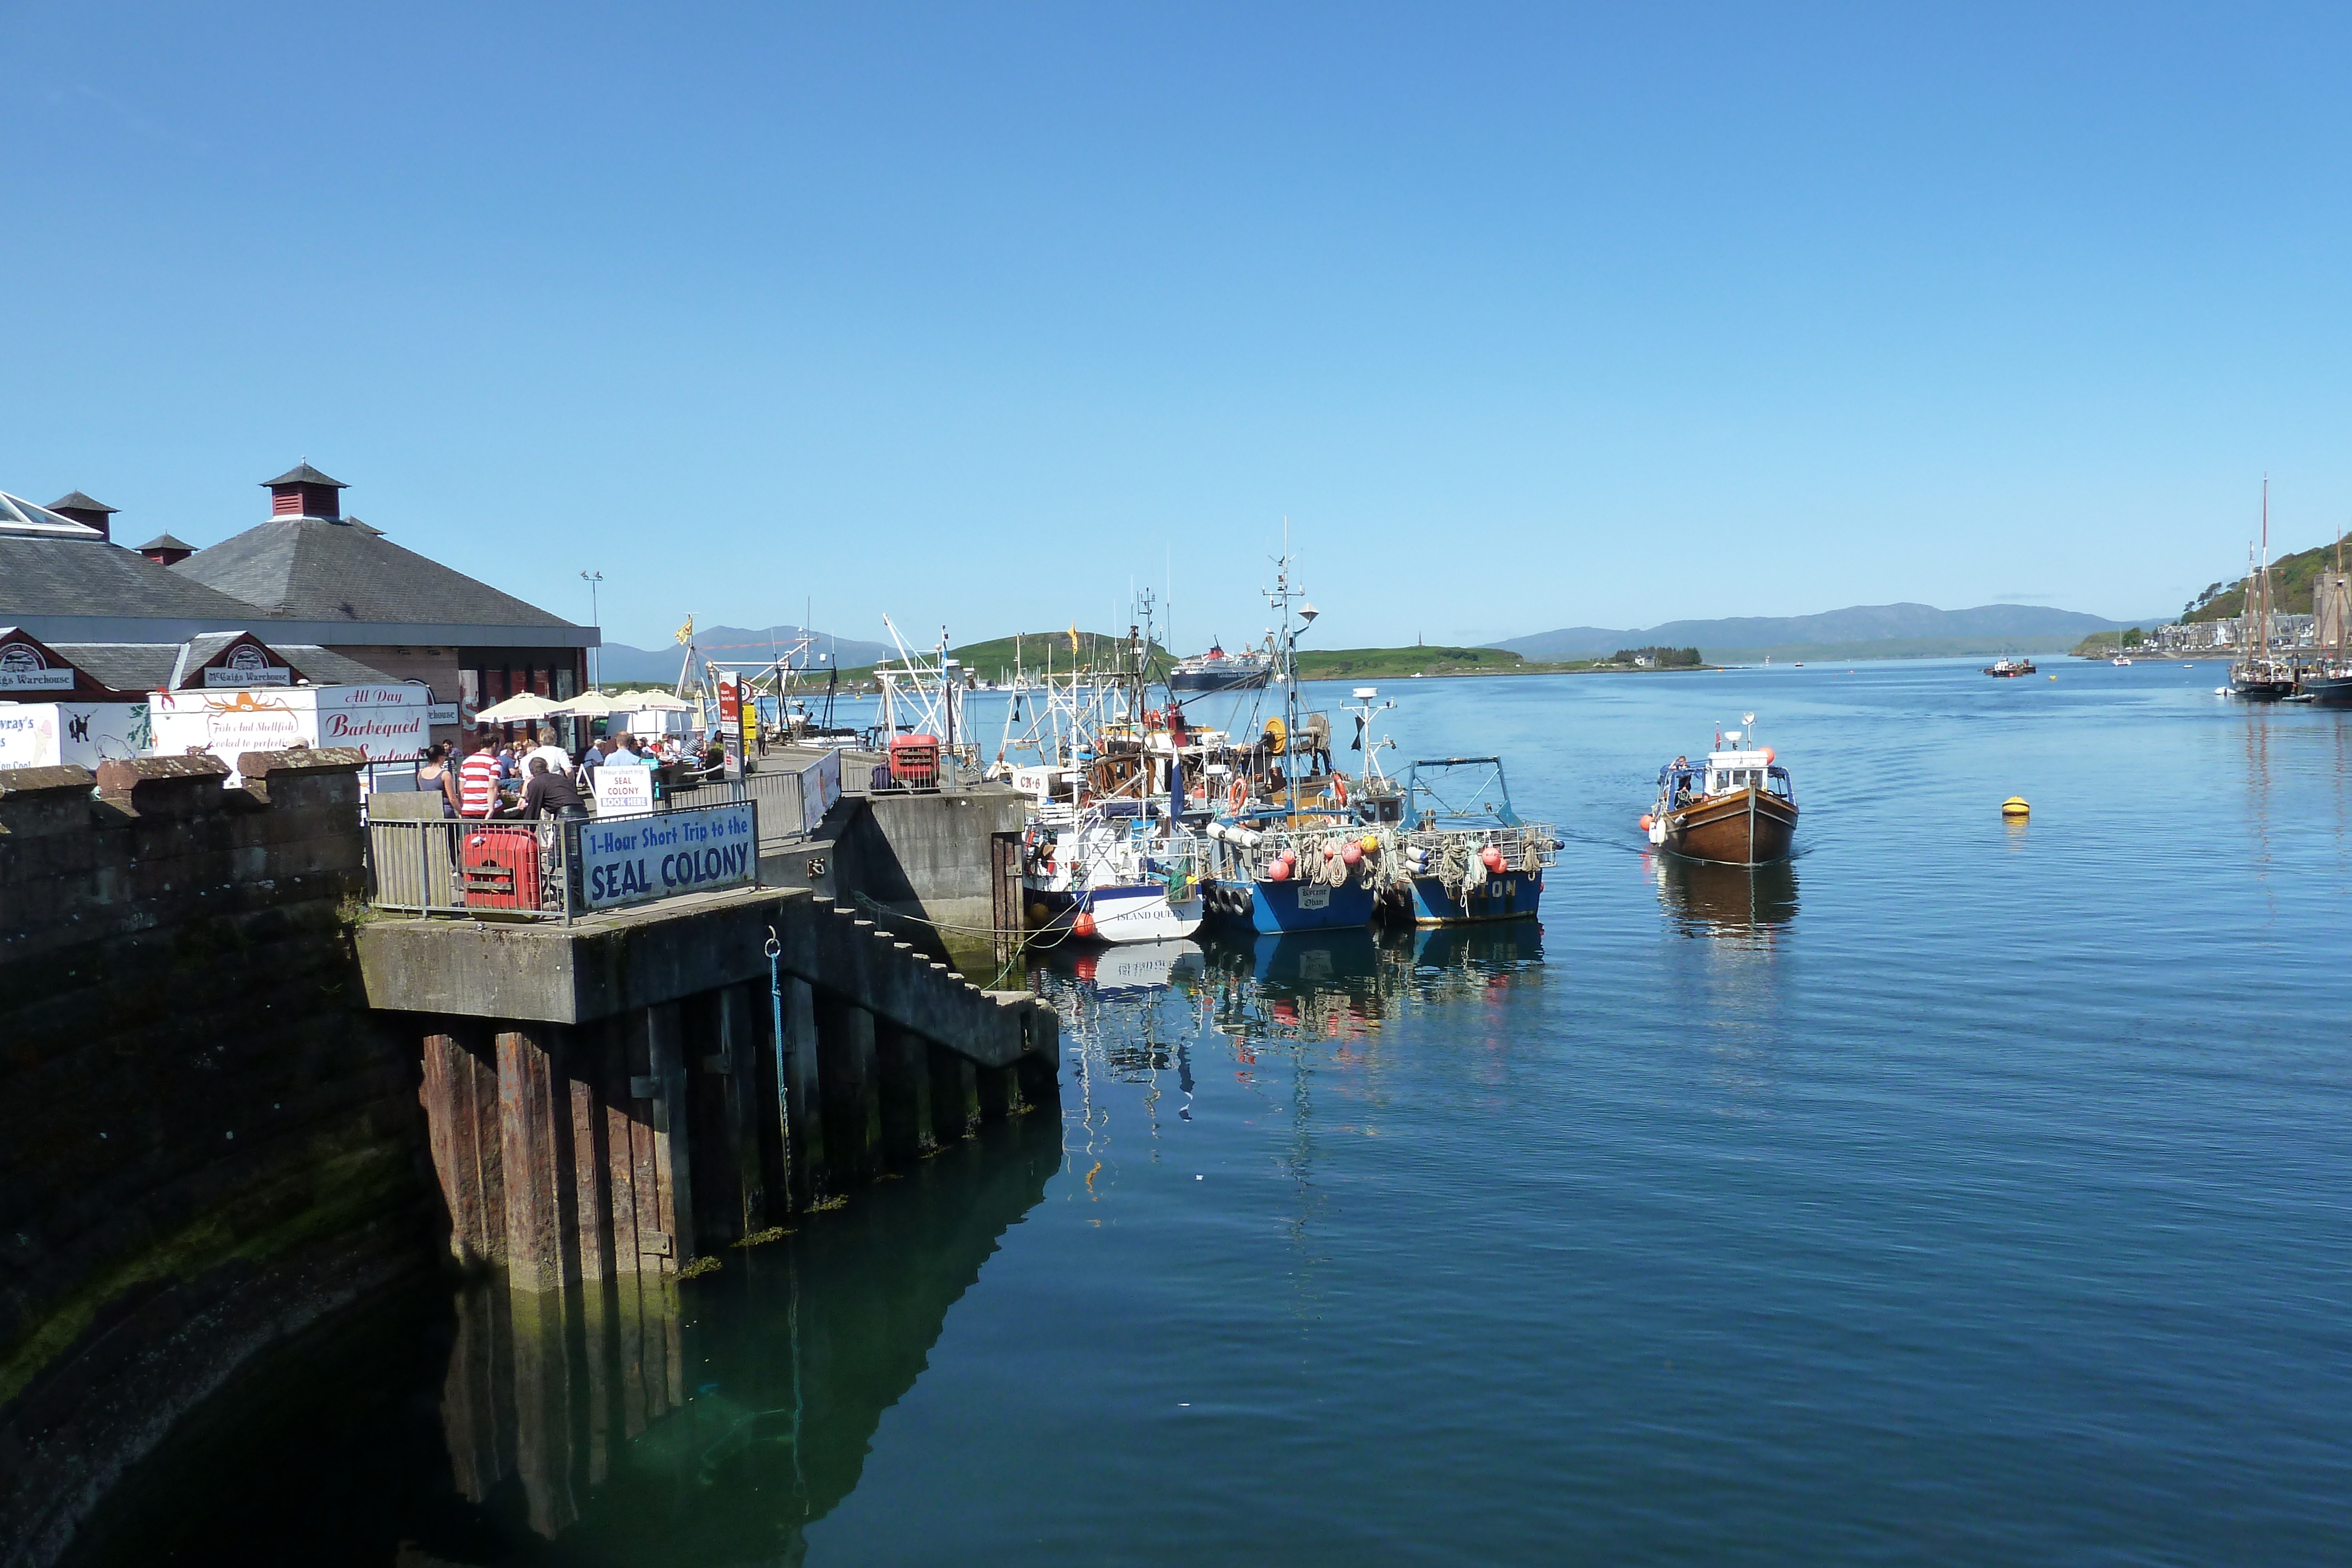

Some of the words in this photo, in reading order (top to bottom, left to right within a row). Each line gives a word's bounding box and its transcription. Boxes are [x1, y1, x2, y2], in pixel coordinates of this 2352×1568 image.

[16, 674, 70, 684] Warehouse
[246, 672, 287, 681] Warehouse
[346, 690, 369, 703] All
[373, 689, 402, 703] Day
[213, 723, 231, 734] Fish
[256, 721, 294, 733] Shellfish
[326, 713, 420, 737] Barbequed
[243, 739, 250, 747] to
[253, 738, 292, 749] perfectio
[634, 767, 644, 776] trip
[602, 798, 626, 806] BOOK
[627, 798, 646, 806] HERE
[589, 832, 637, 854] 1-Hour
[642, 827, 678, 848] Short
[683, 823, 707, 842] Trip
[711, 821, 724, 837] to
[728, 816, 748, 834] the
[592, 858, 652, 901] SEAL
[662, 841, 749, 887] COLONY
[1304, 898, 1324, 907] Oban
[1117, 911, 1151, 921] ISLAND
[1154, 910, 1185, 920] QUEEN
